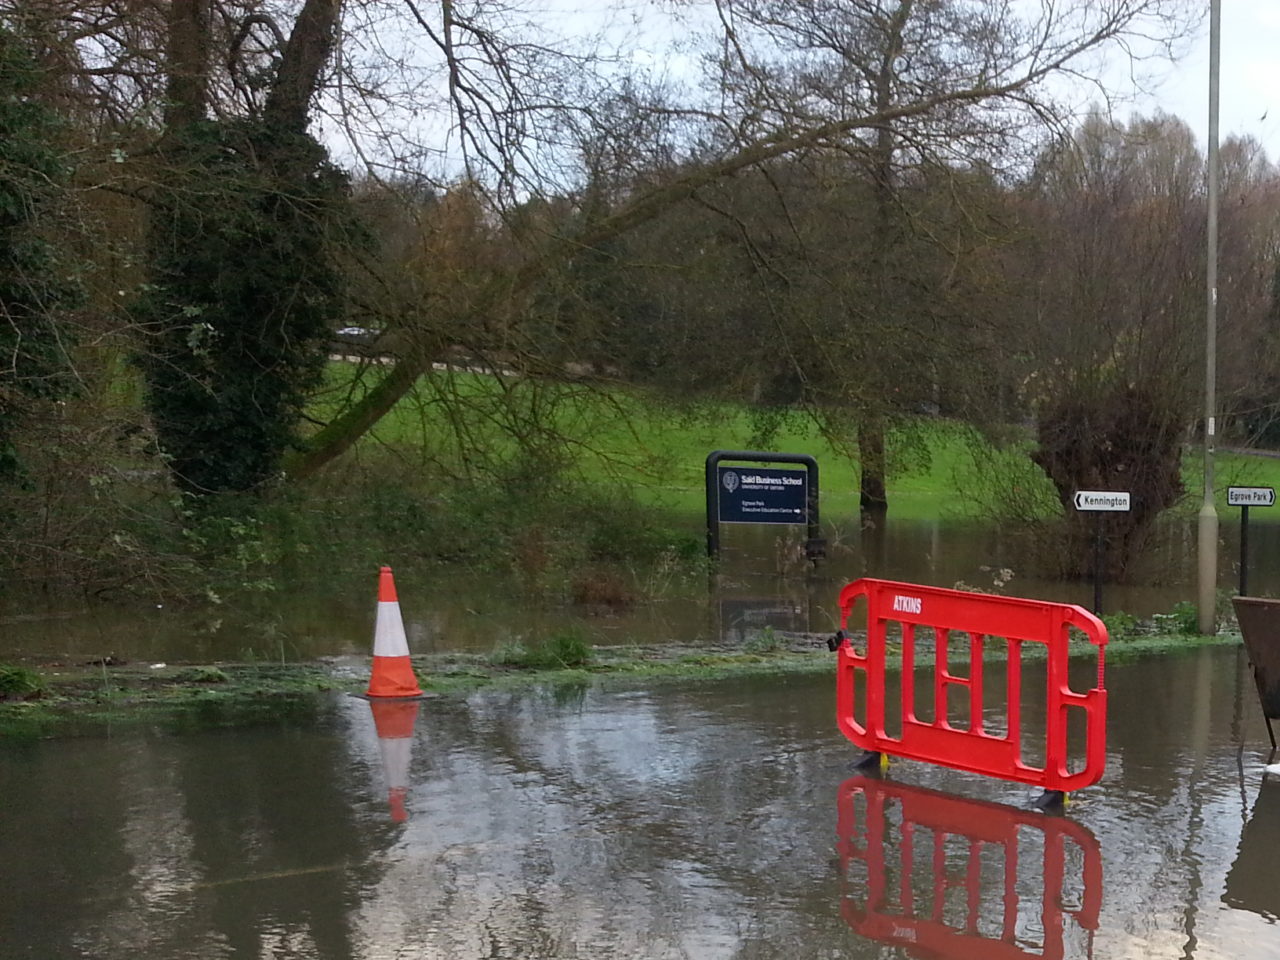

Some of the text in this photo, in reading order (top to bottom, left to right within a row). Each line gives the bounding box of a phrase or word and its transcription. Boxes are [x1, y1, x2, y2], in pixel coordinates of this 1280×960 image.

[756, 476, 782, 484] Business
[782, 476, 802, 485] School
[1084, 496, 1128, 507] Kennington
[1230, 491, 1267, 502] Egrove Park
[893, 595, 921, 614] ATKINS
